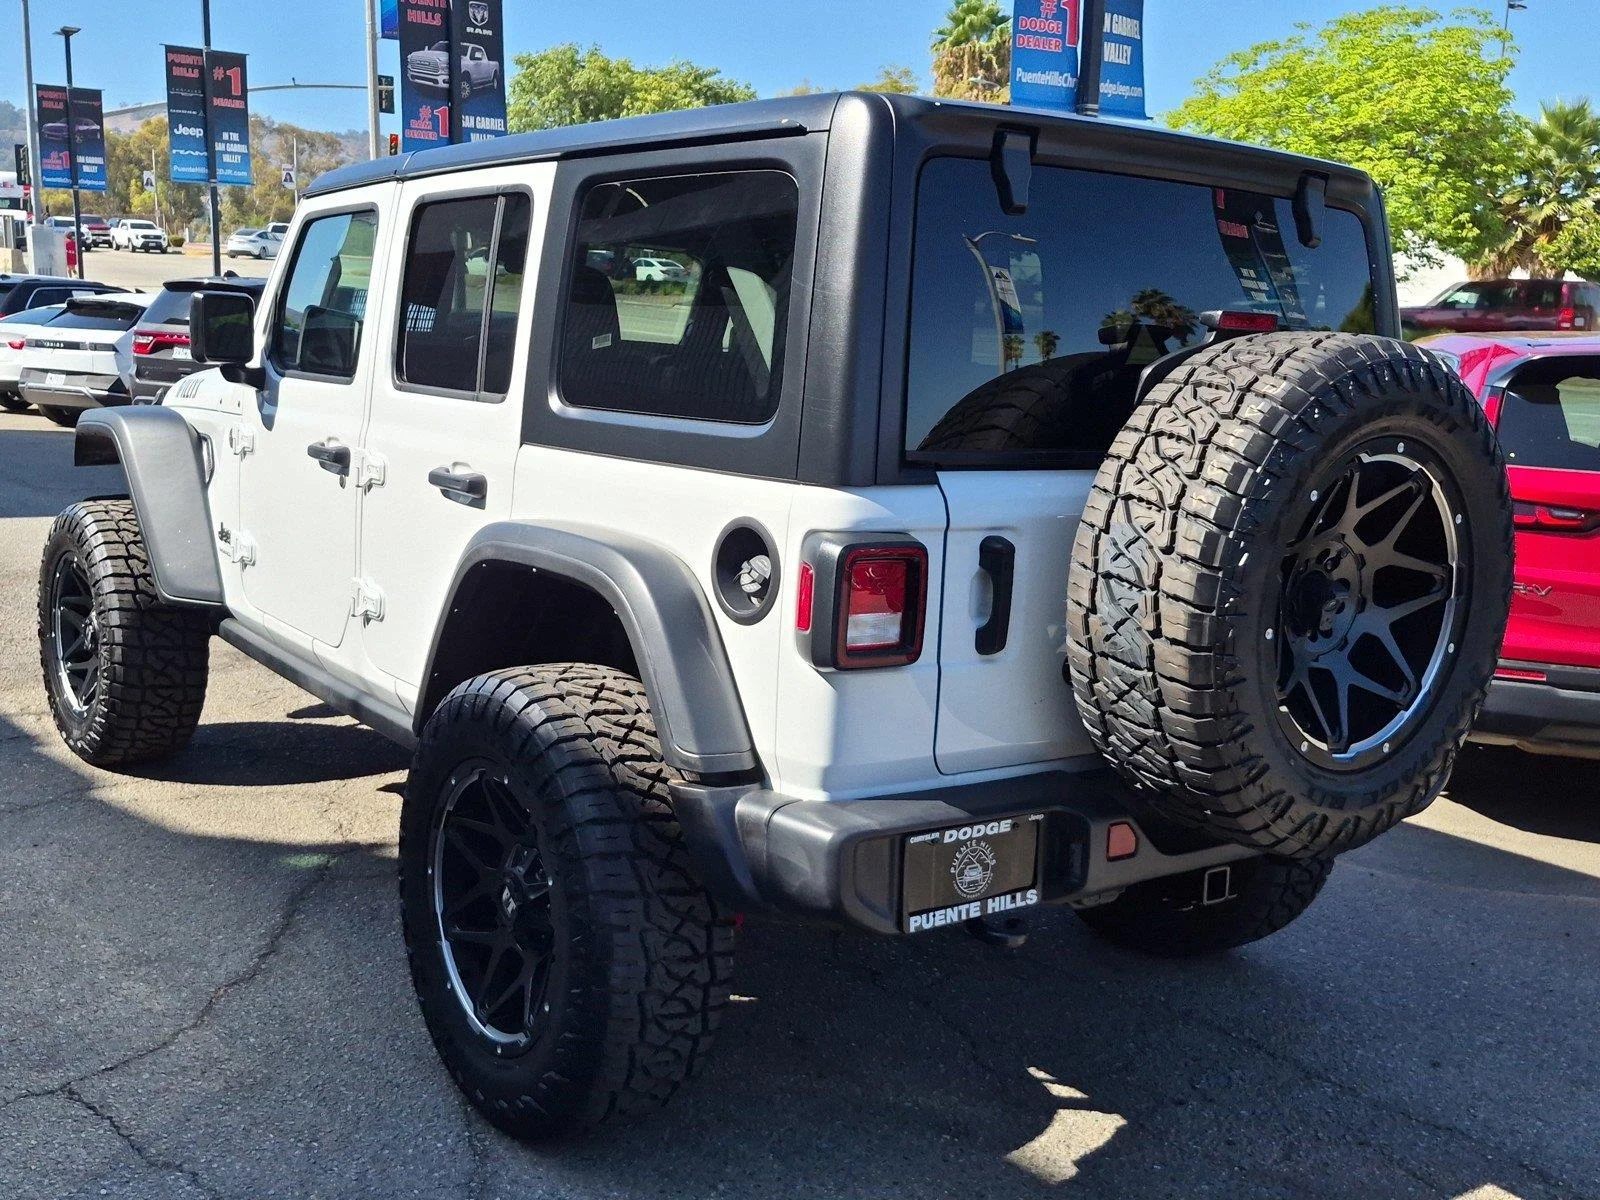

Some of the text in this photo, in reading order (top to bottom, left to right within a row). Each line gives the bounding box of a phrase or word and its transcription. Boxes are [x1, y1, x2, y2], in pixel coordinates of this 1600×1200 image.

[407, 8, 442, 26] HILLS
[1019, 16, 1062, 34] DODGE
[1112, 13, 1141, 39] GABRIEL
[466, 26, 493, 36] RAM
[1016, 34, 1062, 52] DEALER
[1103, 41, 1132, 65] VALLEY
[213, 66, 242, 96] #1
[173, 123, 204, 138] Jeep
[418, 105, 449, 138] #1
[475, 116, 505, 131] GABRIEL
[222, 153, 242, 164] VALLEY
[943, 819, 1012, 844] DODGE
[1028, 813, 1045, 822] Jeep
[909, 888, 1038, 934] PUENTE HILLS
